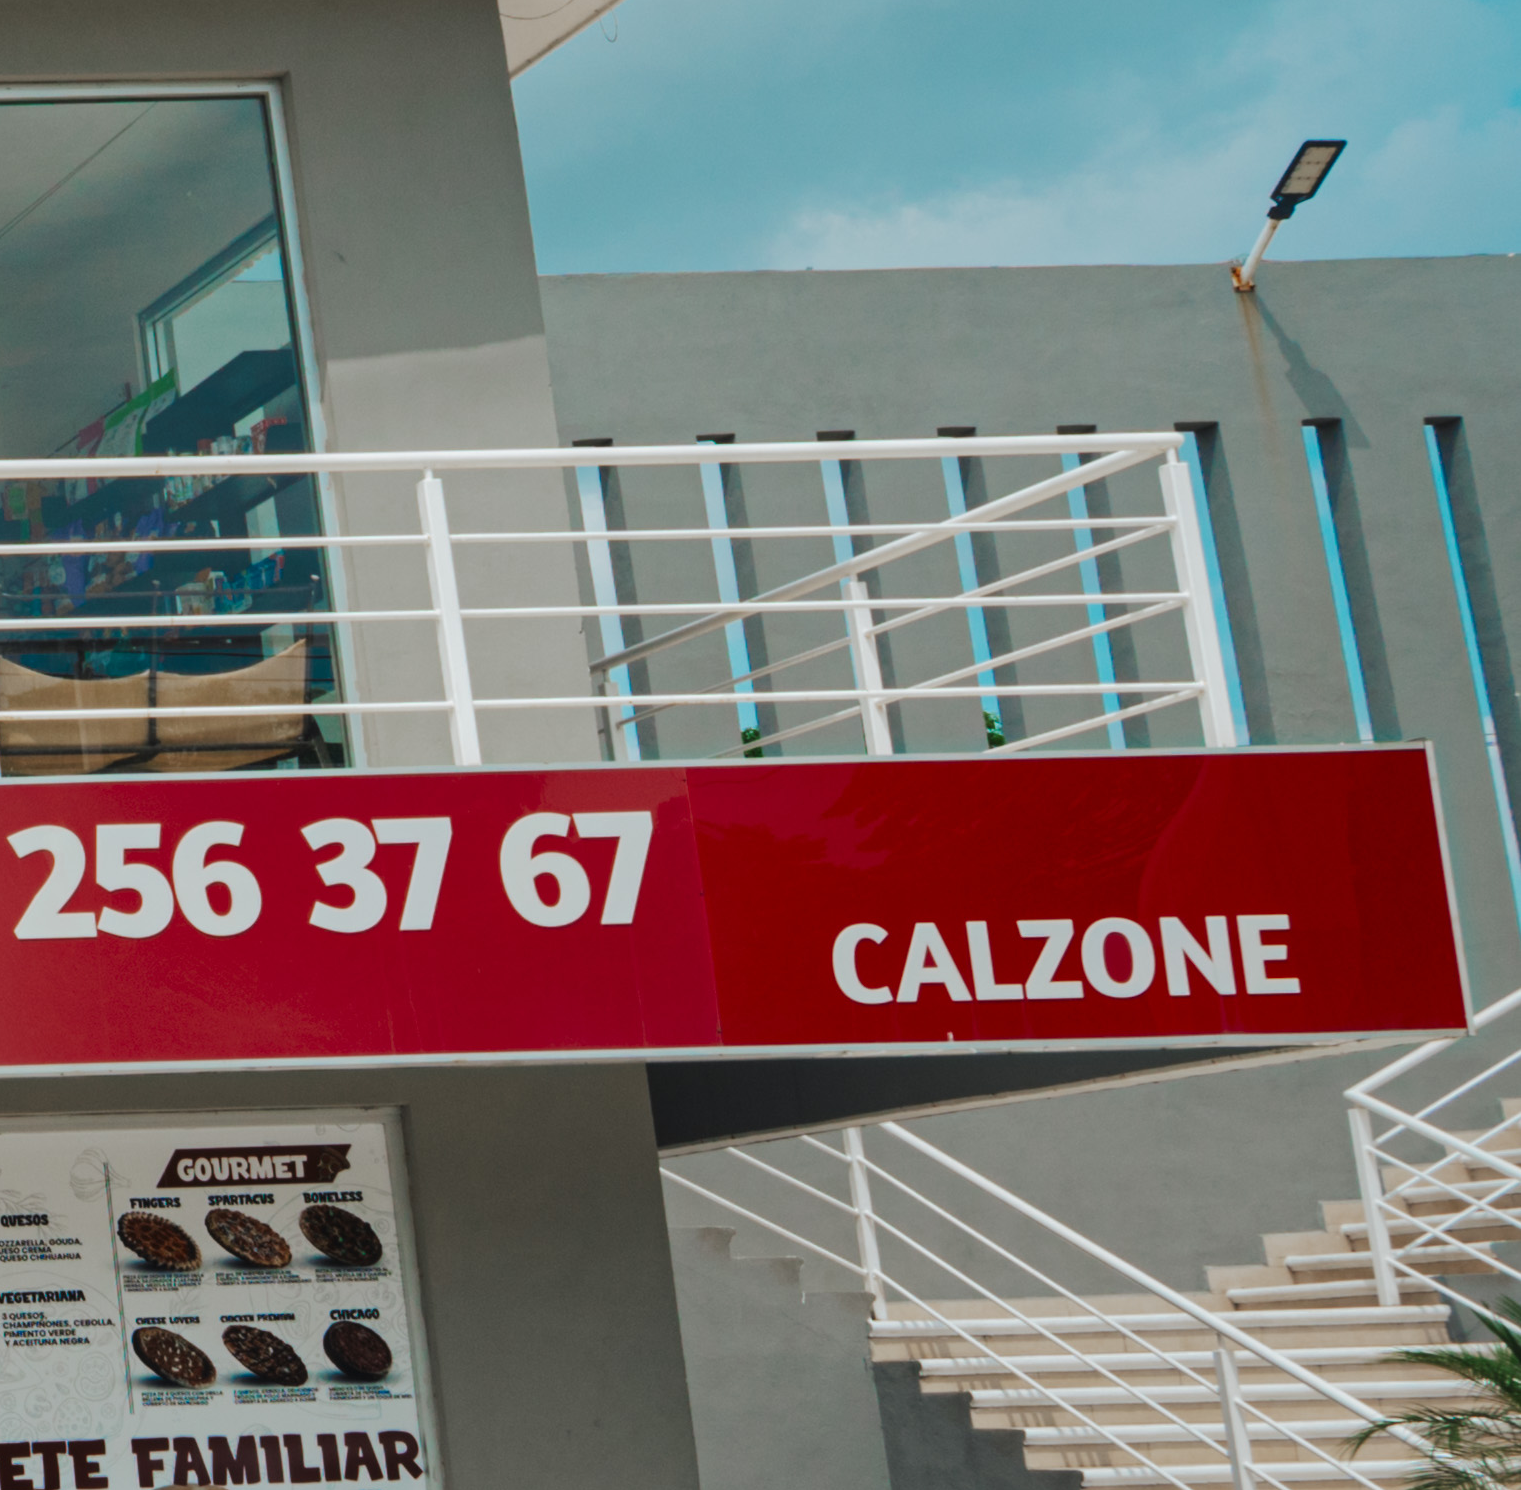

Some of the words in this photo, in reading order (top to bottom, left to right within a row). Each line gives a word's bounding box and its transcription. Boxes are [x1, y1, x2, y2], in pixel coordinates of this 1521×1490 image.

[6, 820, 262, 943] 256
[300, 814, 453, 934] 37
[498, 808, 654, 929] 67
[832, 913, 1301, 1005] CALZONE
[176, 1154, 308, 1182] GOURMET
[131, 1430, 424, 1488] FAMILIAR
